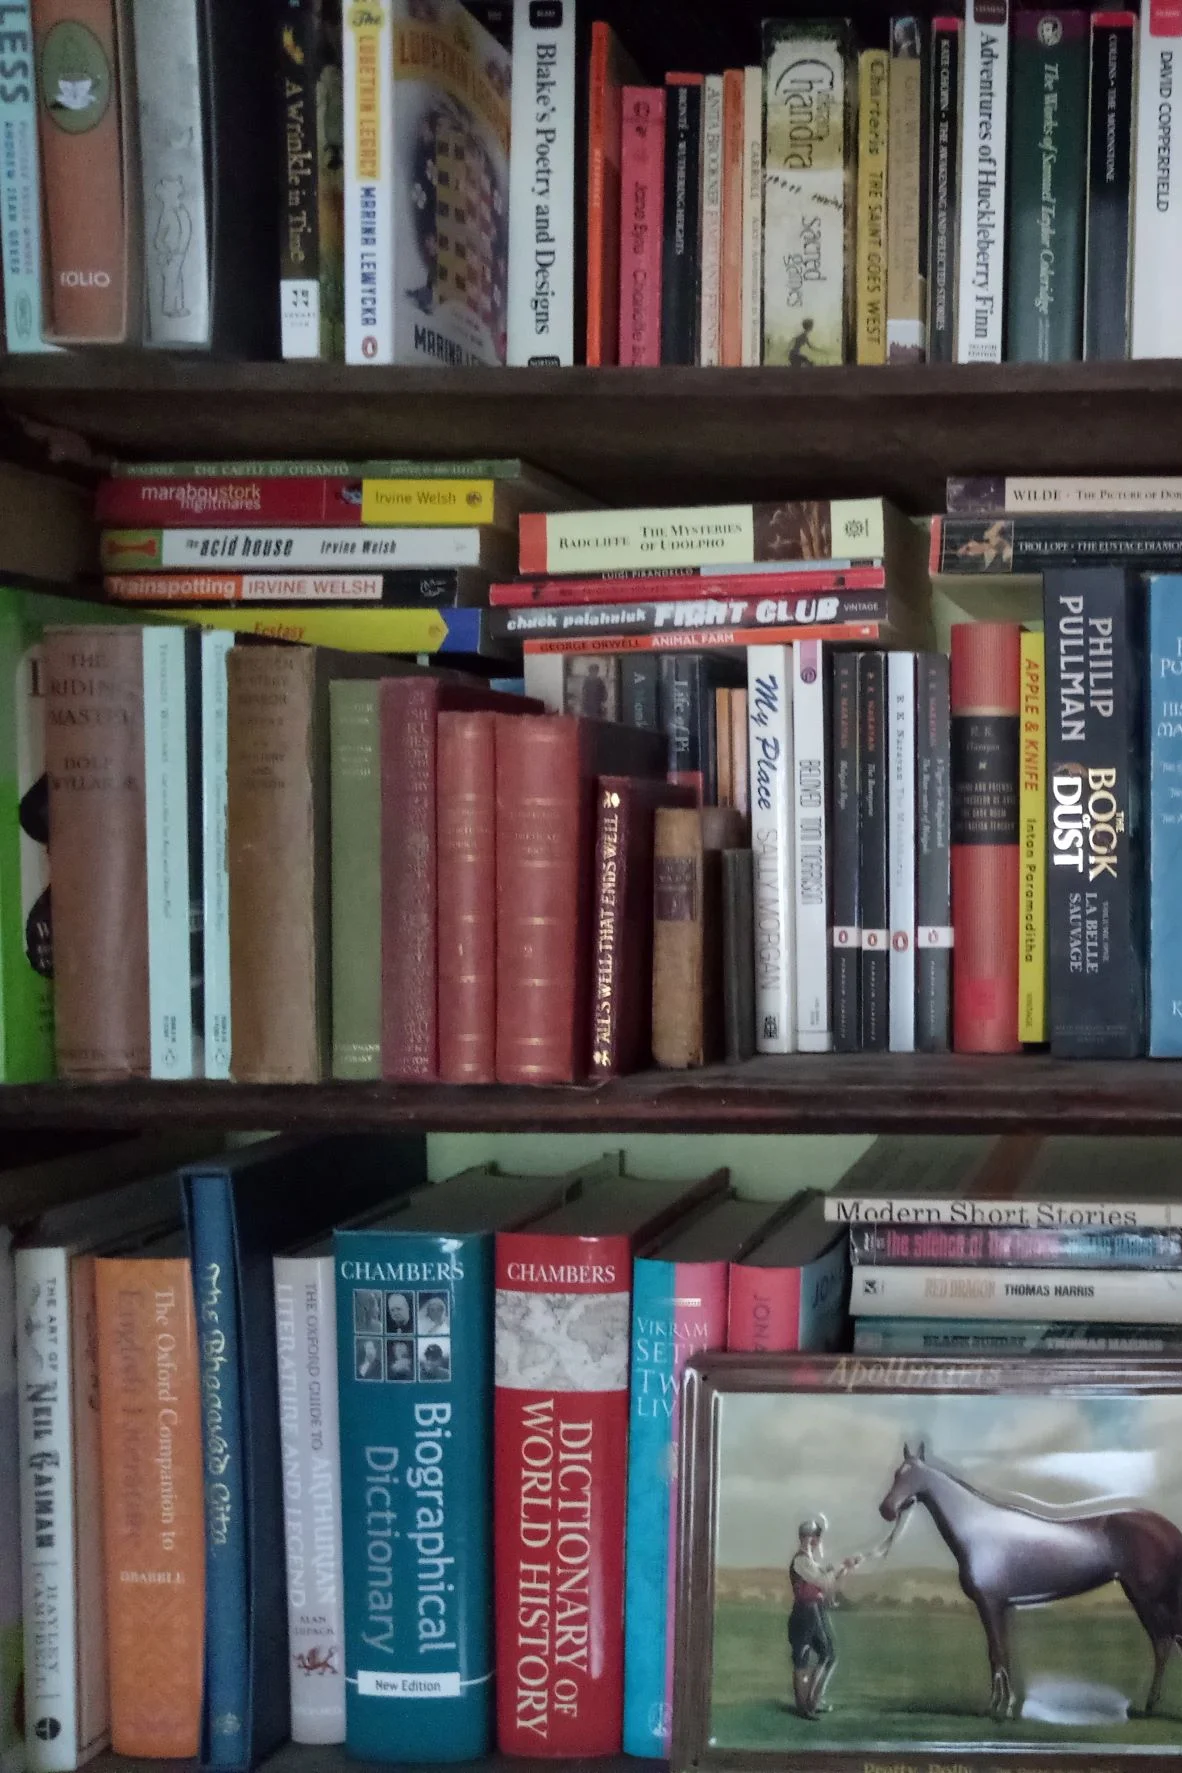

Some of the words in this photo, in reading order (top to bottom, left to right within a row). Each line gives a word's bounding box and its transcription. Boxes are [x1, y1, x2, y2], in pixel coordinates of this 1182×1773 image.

[536, 42, 557, 123] Blake's
[976, 31, 998, 140] Adventures
[1159, 51, 1174, 100] DAVID
[867, 59, 885, 156] Charteris
[532, 128, 556, 201] Poetry
[977, 144, 997, 164] of
[1155, 103, 1173, 213] COPPERFIELD
[868, 171, 883, 197] THE
[360, 186, 377, 247] MARINA
[535, 205, 557, 242] and
[868, 205, 883, 248] SAINT
[971, 169, 995, 290] Huckleberry
[360, 251, 377, 328] LEWYCKA
[530, 249, 556, 336] Designs
[867, 252, 882, 294] GOES
[866, 299, 881, 346] WEST
[973, 295, 994, 340] Finn
[140, 483, 262, 502] maraboustork
[180, 497, 262, 514] nightmares
[374, 491, 413, 506] Irvine
[416, 490, 457, 505] Welsh
[199, 535, 239, 558] acid
[241, 536, 294, 558] house
[319, 539, 358, 555] Irvine
[361, 539, 397, 555] Welsh
[247, 579, 308, 595] IRVINE
[311, 579, 377, 595] WELSH
[506, 615, 557, 631] chuck
[562, 609, 648, 629] palahniuk
[653, 598, 748, 629] FIGHT
[755, 596, 841, 623] CLUB
[843, 602, 880, 612] VINTAGE
[1059, 594, 1087, 742] PULLMAN
[1087, 616, 1115, 718] PHILIP
[752, 674, 780, 727] My
[754, 736, 782, 811] Place
[1052, 774, 1085, 873] DUST
[1086, 766, 1119, 882] BOOK
[755, 828, 779, 889] SALLY
[1085, 891, 1099, 916] LA
[759, 902, 781, 990] MORGAN
[1067, 892, 1083, 973] SAUVAGE
[1085, 919, 1099, 974] BELLE
[835, 1201, 941, 1226] Modern
[950, 1202, 1028, 1227] Short
[1037, 1203, 1138, 1227] Stories
[304, 1282, 318, 1311] THE
[340, 1260, 465, 1282] CHAMBERS
[506, 1263, 616, 1284] CHAMBERS
[1004, 1283, 1050, 1297] THOMAS
[1054, 1284, 1096, 1297] HARRIS
[153, 1287, 175, 1326] The
[154, 1331, 178, 1401] Oxford
[305, 1313, 320, 1378] OXFORD
[307, 1380, 321, 1422] GUIDE
[152, 1406, 178, 1525] Companion
[309, 1429, 322, 1452] TO
[519, 1397, 554, 1548] WORLD
[160, 1530, 178, 1551] to
[309, 1457, 338, 1602] ARTHURIAN
[360, 1444, 401, 1655] Dictionary
[405, 1401, 458, 1655] Biographical
[554, 1419, 594, 1675] DICTIONARY
[515, 1560, 551, 1740] HISTORY
[374, 1678, 400, 1693] New
[401, 1677, 442, 1692] Edition
[552, 1678, 580, 1719] OF
